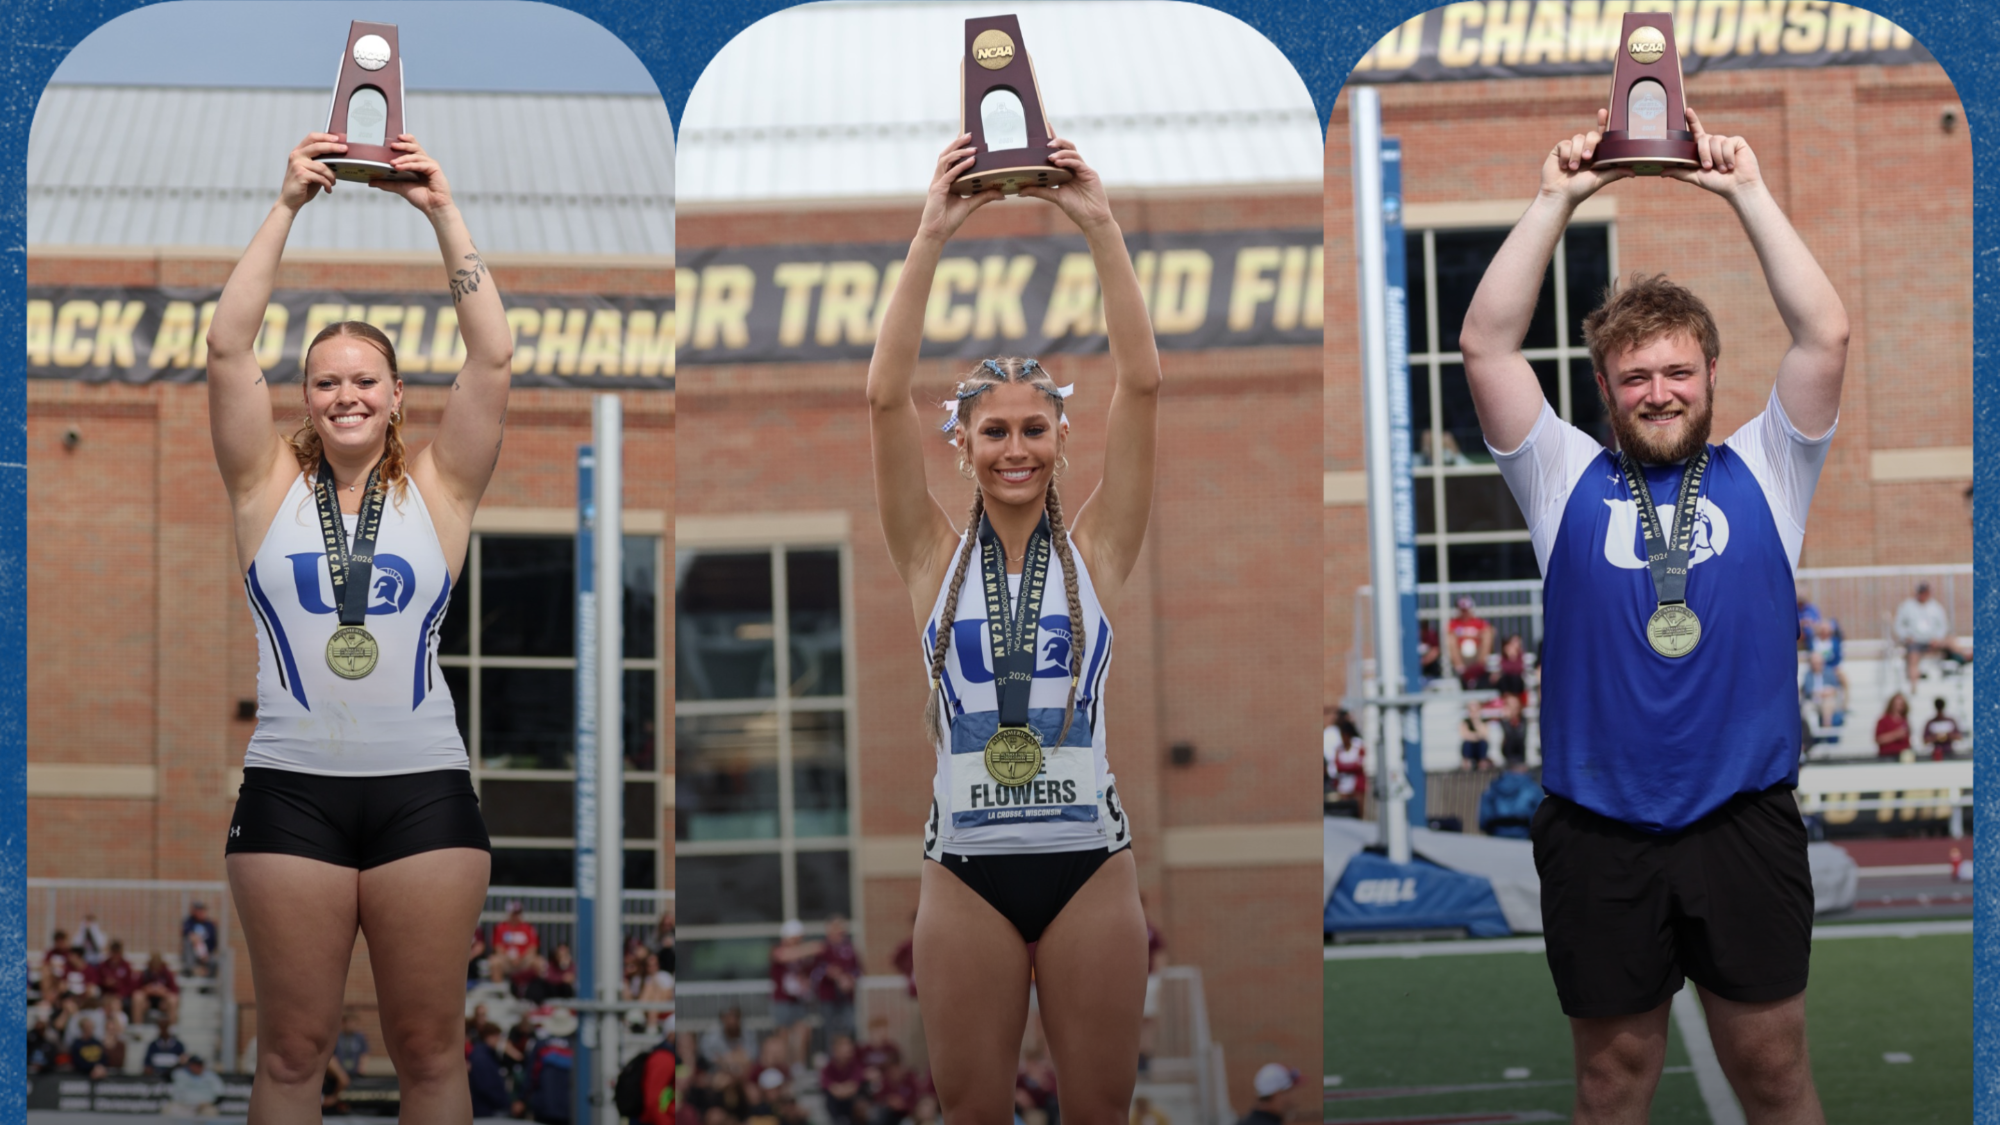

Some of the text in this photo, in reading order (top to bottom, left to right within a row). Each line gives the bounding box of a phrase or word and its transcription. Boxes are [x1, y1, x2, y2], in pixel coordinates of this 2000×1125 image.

[1437, 0, 1914, 68] CHAMIONSHI
[977, 46, 1013, 59] NCAA
[1631, 43, 1664, 54] NCAA
[300, 303, 467, 374] FELD
[1638, 476, 1651, 503] OUTDOOR
[1646, 502, 1656, 519] TRACK
[1653, 523, 1661, 538] FIELD
[1674, 510, 1682, 533] DIVISION
[1679, 476, 1689, 504] OUTDOOR
[1679, 452, 1709, 551] ALL-AMERICAN
[335, 519, 344, 544] OUTDOOR
[352, 554, 373, 564] 2026
[1027, 550, 1035, 567] TRACK
[1666, 567, 1687, 575] 2026
[1021, 567, 1032, 597] OUTDOOR
[1023, 538, 1050, 653] ALL-AMERICAN
[1000, 582, 1008, 612] OUTDOOR
[1017, 603, 1026, 631] DIVISION
[1014, 632, 1022, 651] NCAA
[1009, 671, 1032, 682] 2026
[970, 779, 1077, 808] FLOWERS
[988, 811, 996, 820] LA
[1025, 808, 1062, 818] WISCONSIN
[1353, 877, 1418, 904] GILL
